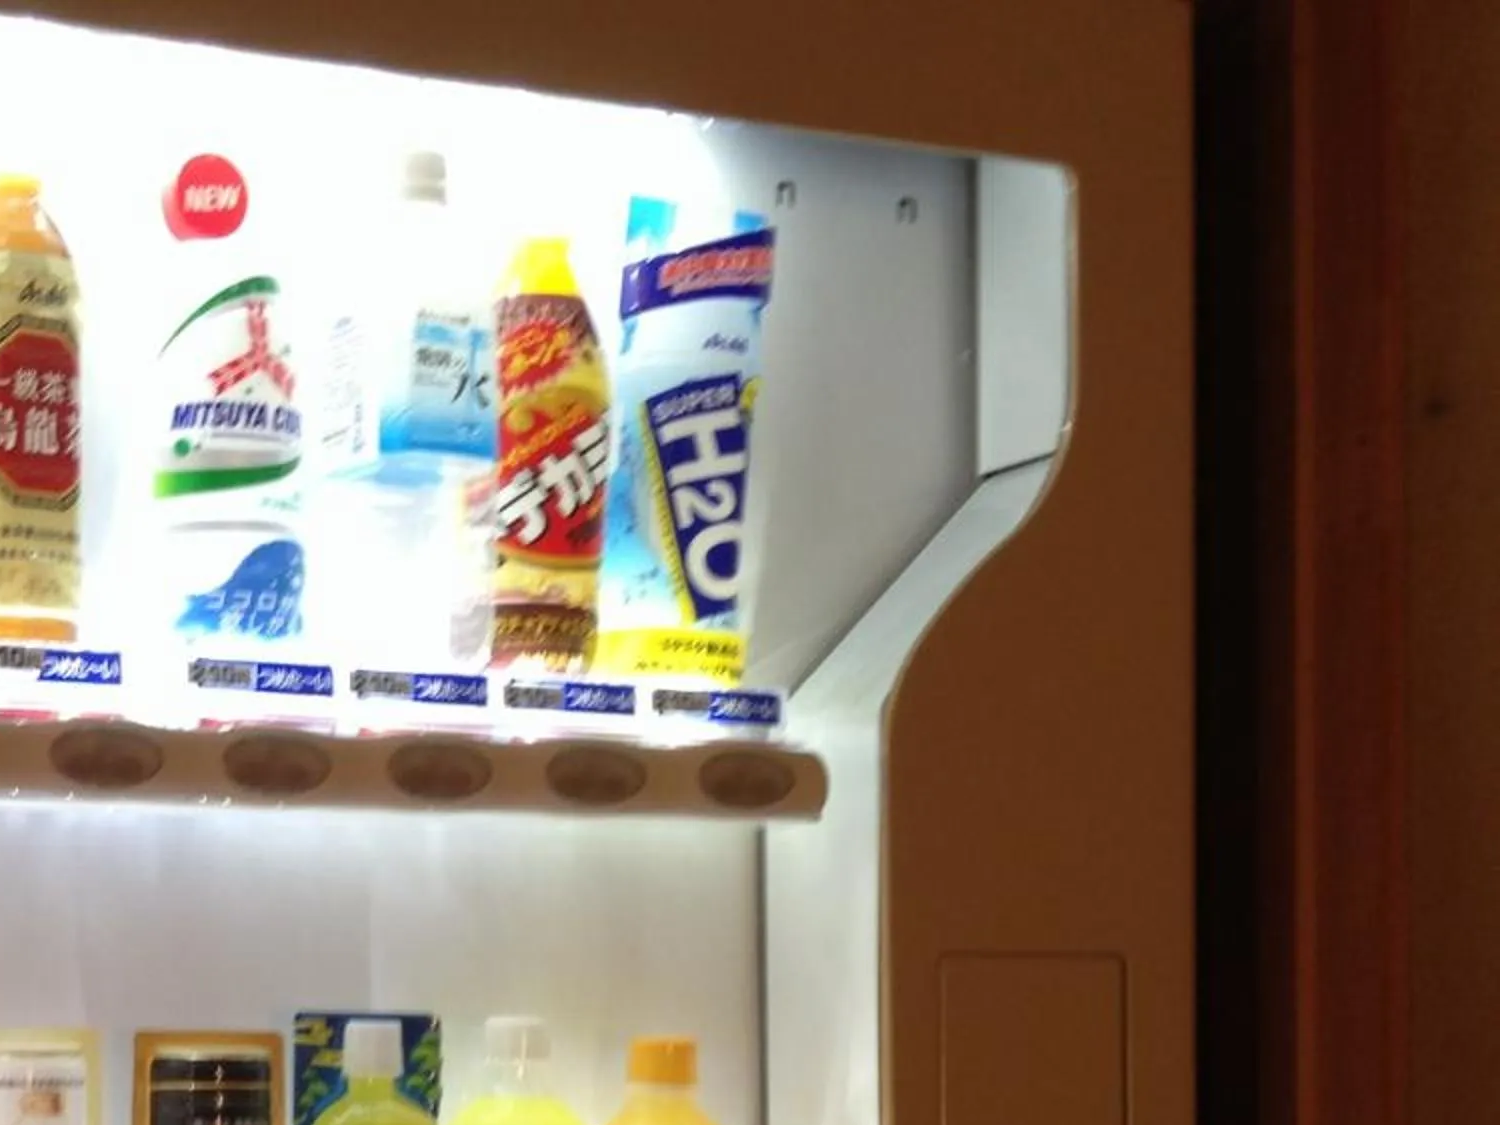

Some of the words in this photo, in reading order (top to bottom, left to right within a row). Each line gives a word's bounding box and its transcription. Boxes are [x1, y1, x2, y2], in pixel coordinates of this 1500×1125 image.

[184, 183, 242, 212] NEW
[171, 402, 268, 431] MITSUYA
[658, 407, 747, 602] H2O
